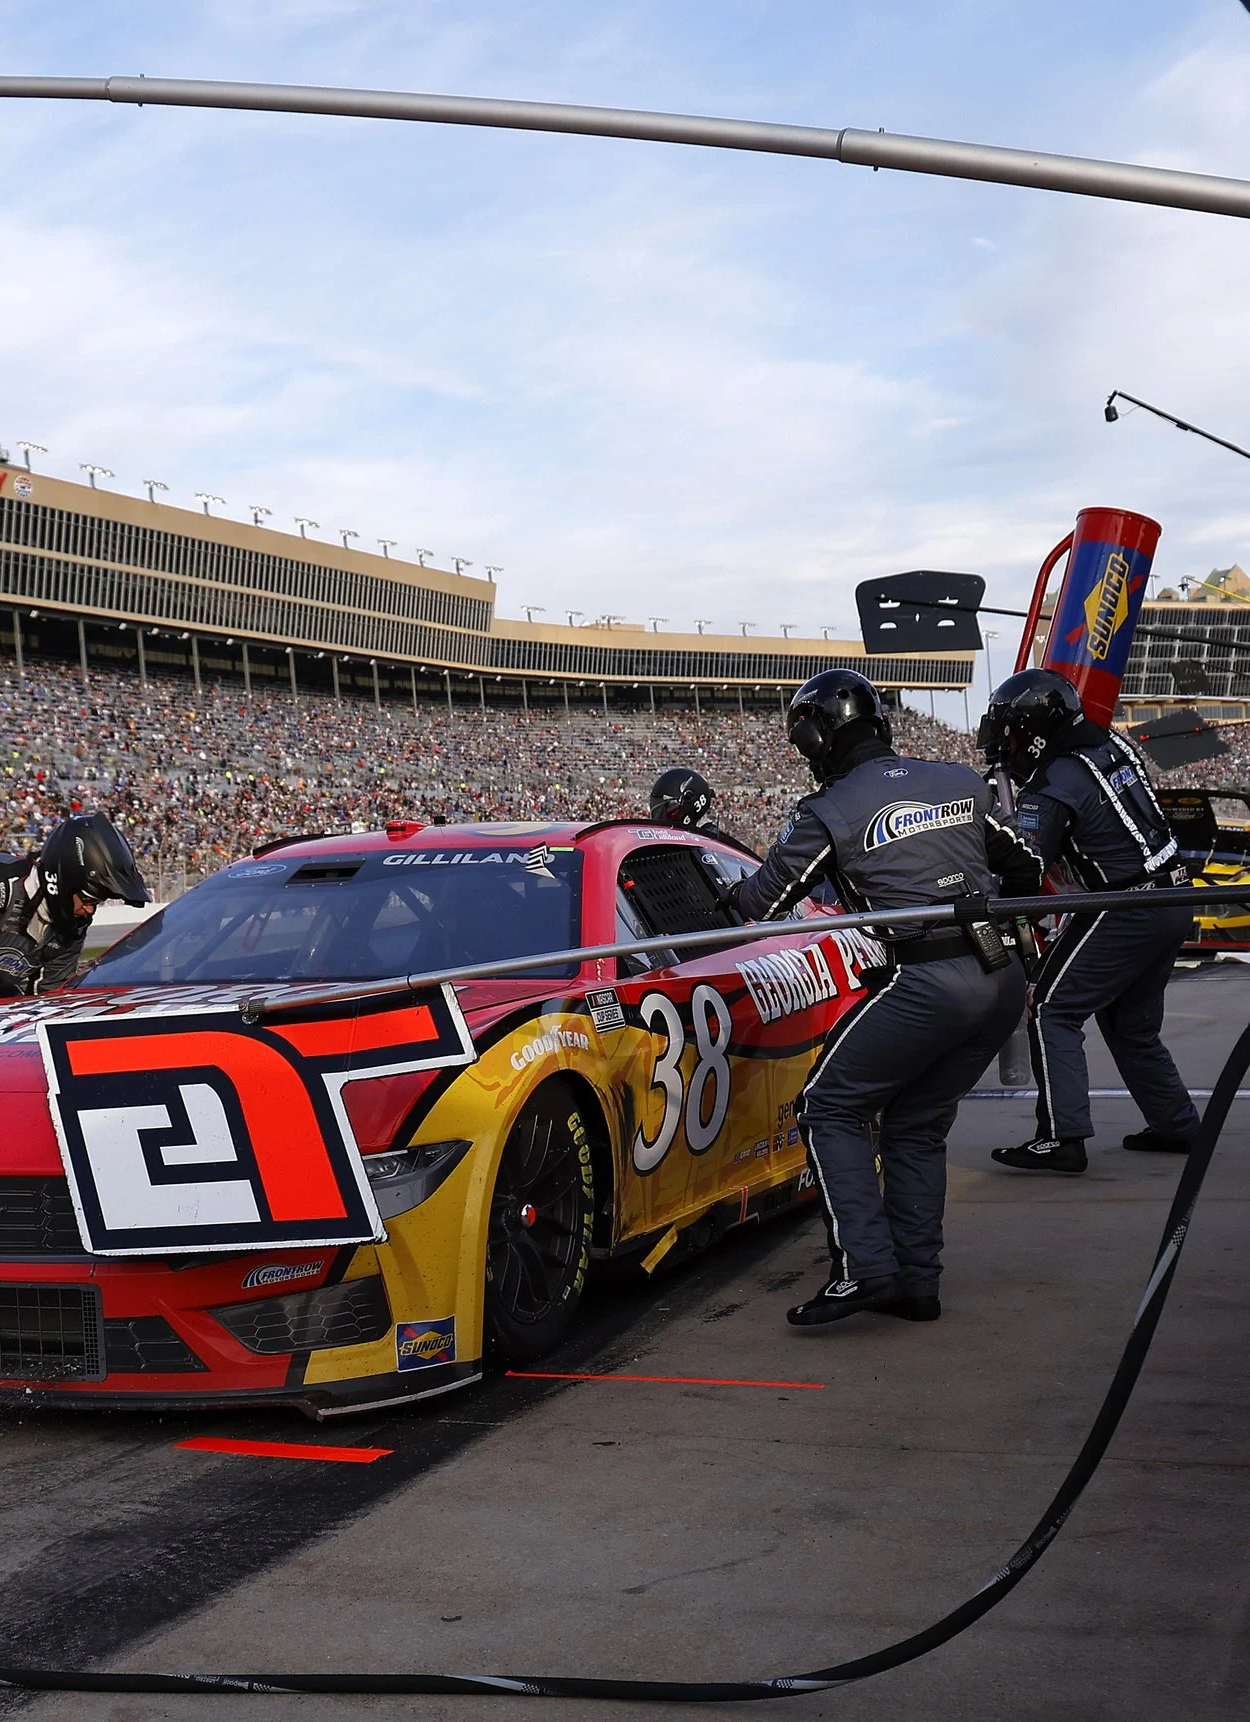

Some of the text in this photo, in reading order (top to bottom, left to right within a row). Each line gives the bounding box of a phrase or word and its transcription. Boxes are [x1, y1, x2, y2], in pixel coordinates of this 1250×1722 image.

[1088, 555, 1128, 658] SUNOCO
[1028, 736, 1047, 759] 38
[694, 794, 708, 813] 38
[895, 799, 973, 830] FRONTROW
[897, 814, 974, 837] MOTORSPORTS
[938, 873, 964, 886] sparco
[736, 943, 838, 1025] GEORGIA
[510, 1024, 590, 1071] GOODYEAR
[632, 983, 733, 1175] 38
[262, 1261, 324, 1280] FRONTROW
[402, 1333, 451, 1356] SUNOCO
